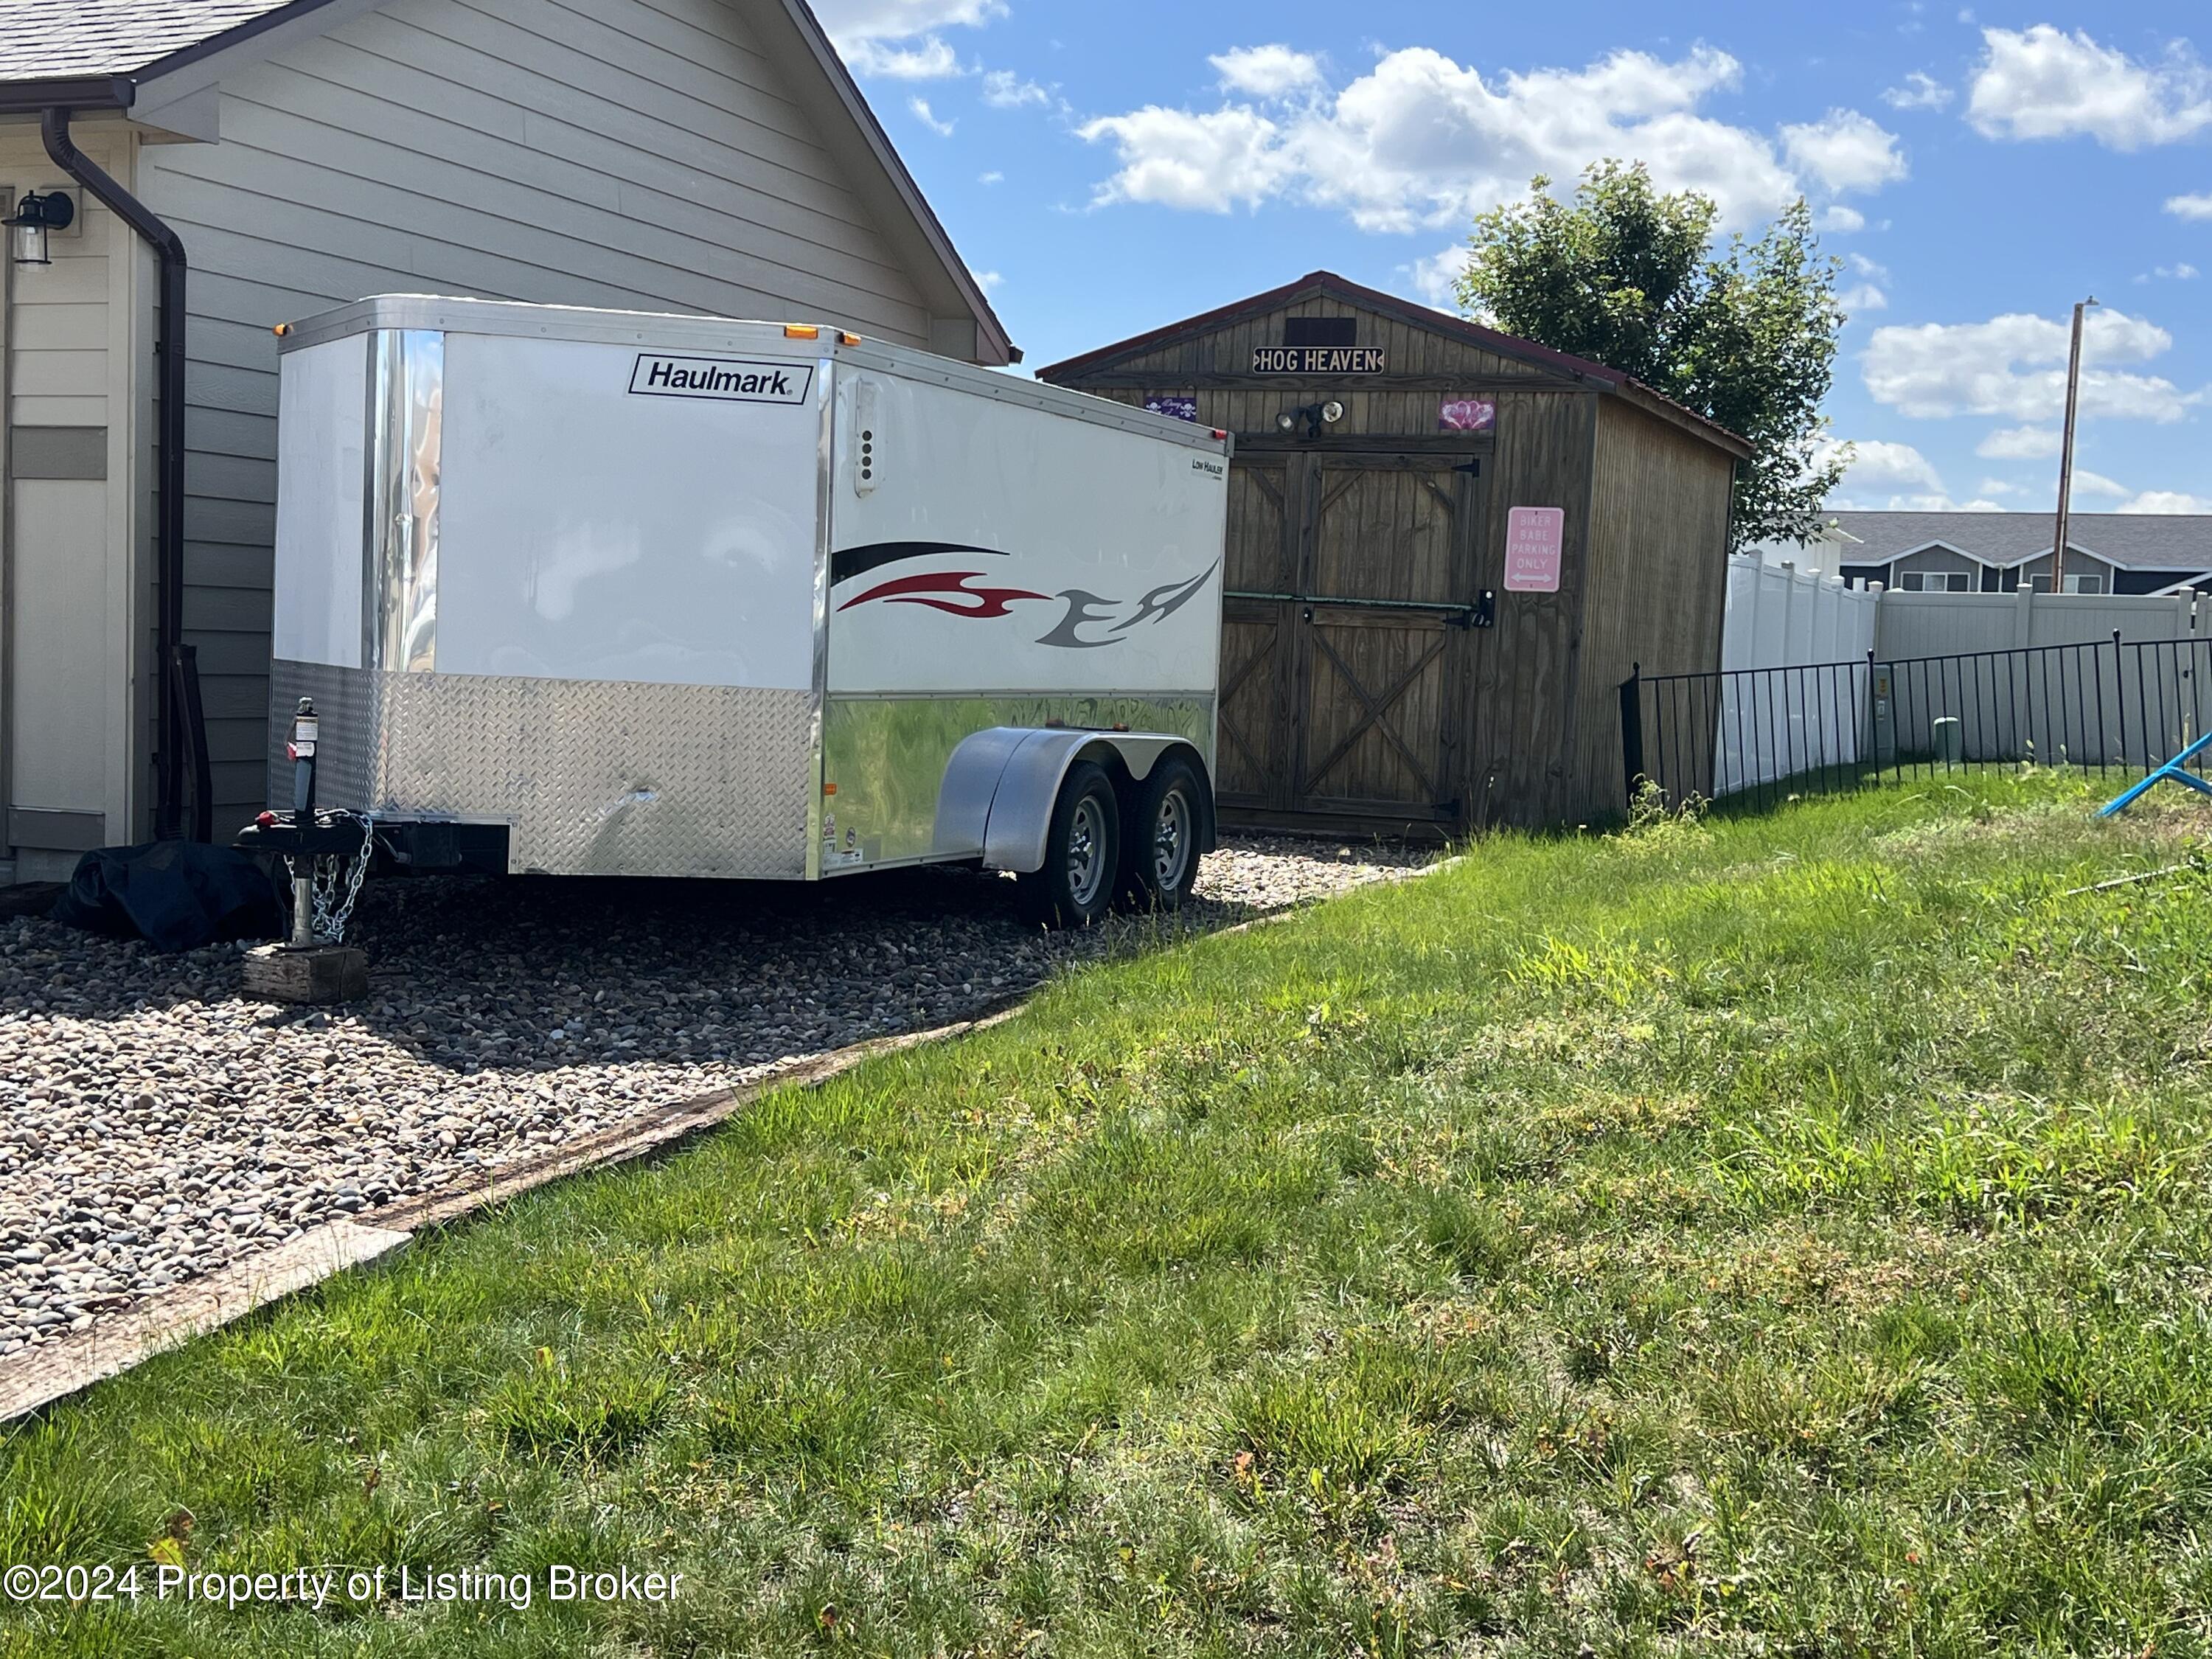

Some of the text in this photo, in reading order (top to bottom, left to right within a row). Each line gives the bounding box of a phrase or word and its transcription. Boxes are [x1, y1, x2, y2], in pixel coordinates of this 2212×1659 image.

[1260, 350, 1377, 371] HOG HEAVEN
[647, 361, 790, 395] Haulmark
[1520, 515, 1551, 526] BIKER
[1520, 529, 1548, 541] BABE
[1511, 543, 1556, 555] PARKING
[1517, 558, 1548, 569] ONLY
